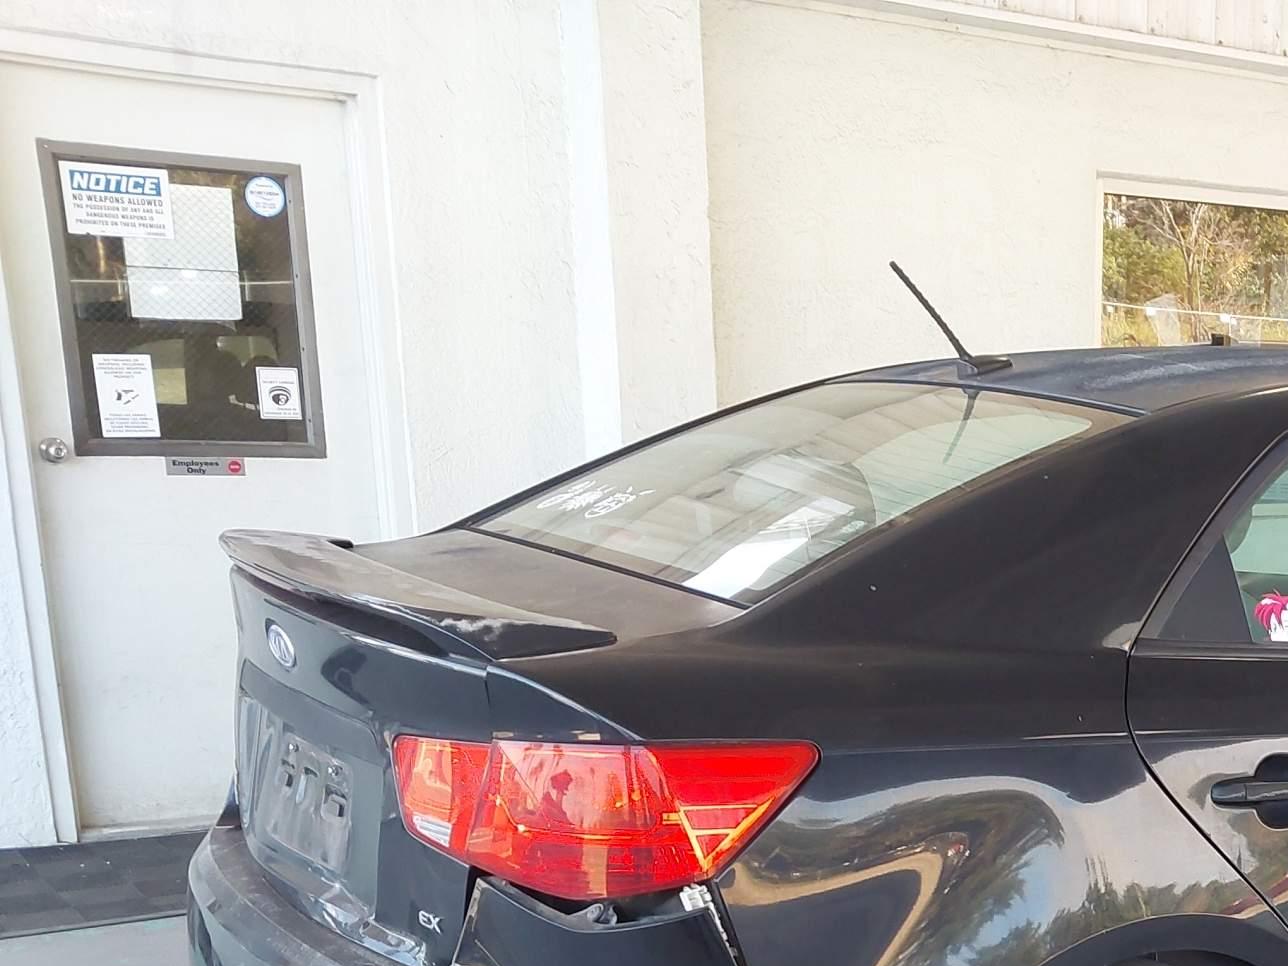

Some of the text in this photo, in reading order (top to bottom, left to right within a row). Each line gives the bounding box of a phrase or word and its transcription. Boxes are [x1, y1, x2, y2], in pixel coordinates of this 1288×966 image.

[72, 172, 158, 195] NOTICE
[72, 193, 163, 207] NO WEAPONS ALLOWED
[172, 459, 219, 467] Employees
[418, 910, 443, 934] EX
